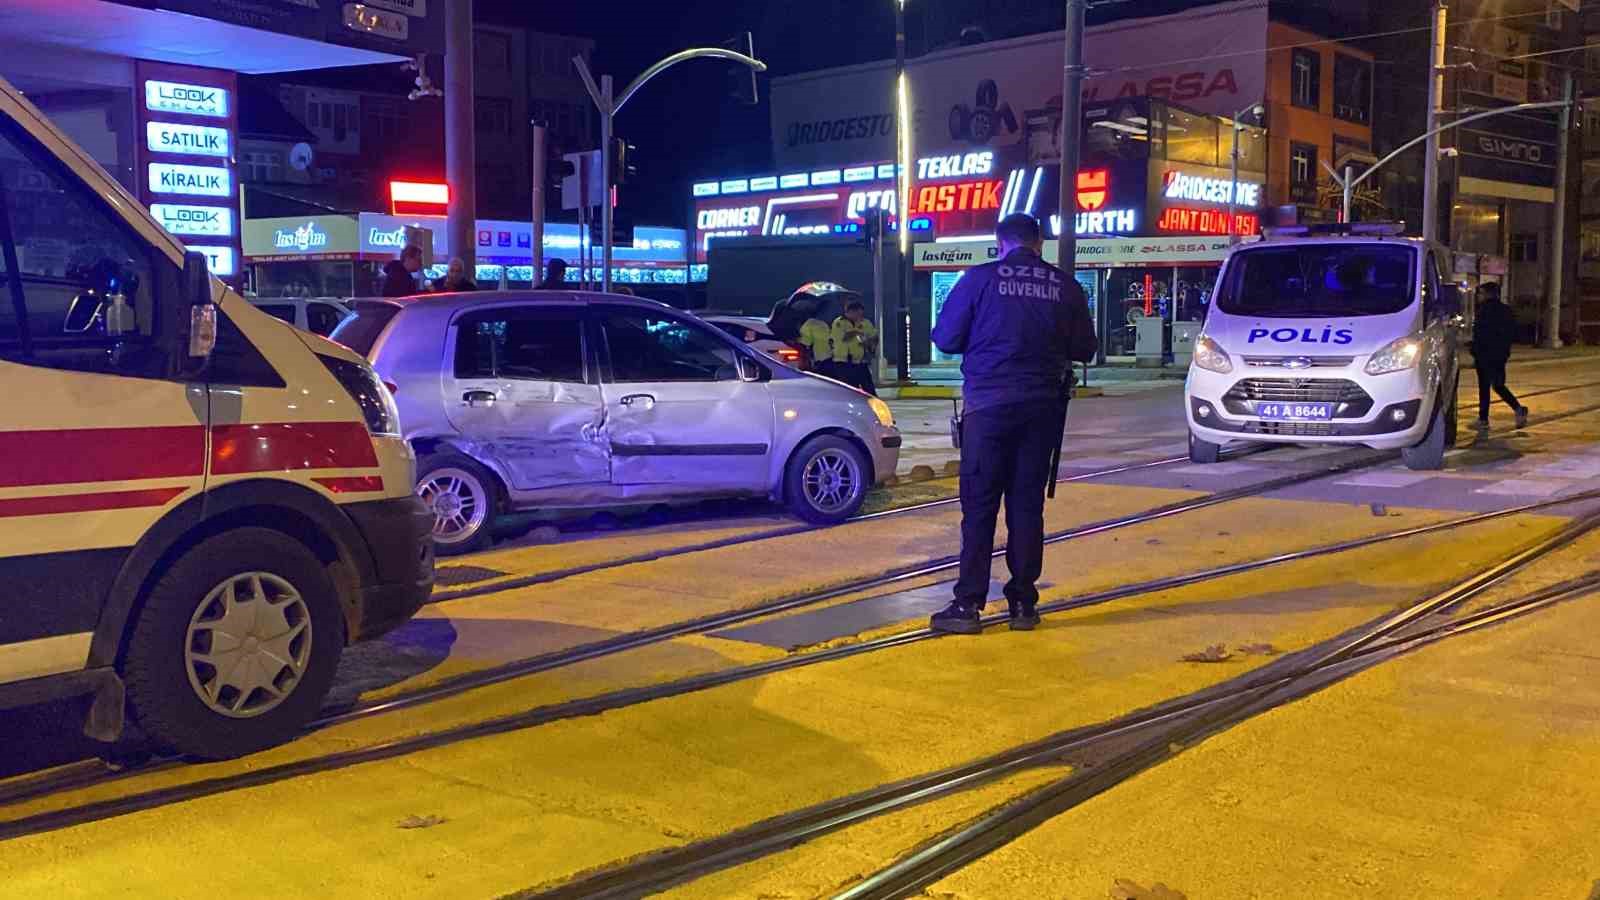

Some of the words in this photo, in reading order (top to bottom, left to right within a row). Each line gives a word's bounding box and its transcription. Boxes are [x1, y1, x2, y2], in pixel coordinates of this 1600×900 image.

[159, 86, 216, 103] LOOK
[785, 109, 926, 148] BRIDGESTOE
[161, 131, 219, 149] SATILIK
[918, 151, 993, 179] TEKLAS
[161, 169, 220, 188] KİRALIK
[1165, 169, 1260, 206] BRIDGESTNE
[163, 208, 219, 223] LOOK
[697, 206, 760, 229] CORNER
[1159, 207, 1199, 231] JANT
[1248, 325, 1352, 344] POLİS
[1263, 405, 1278, 416] 41
[1282, 406, 1292, 417] A
[1295, 406, 1326, 417] 8644
